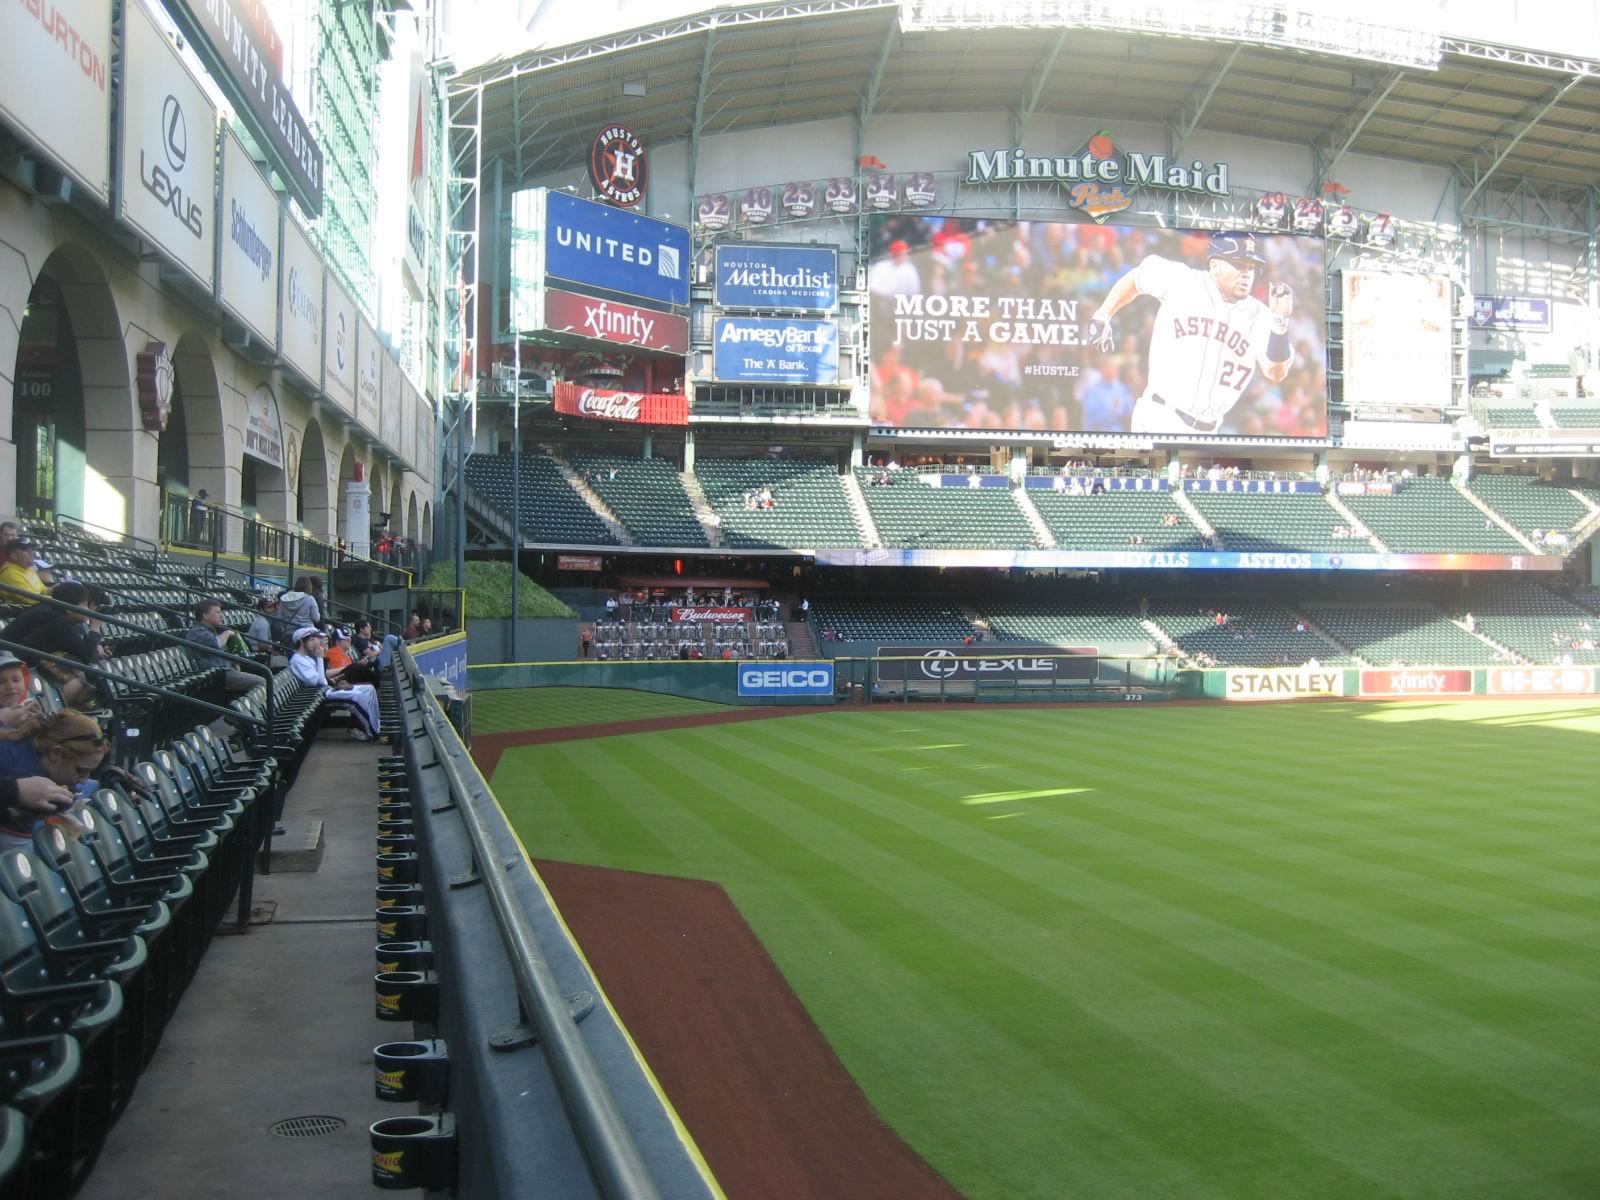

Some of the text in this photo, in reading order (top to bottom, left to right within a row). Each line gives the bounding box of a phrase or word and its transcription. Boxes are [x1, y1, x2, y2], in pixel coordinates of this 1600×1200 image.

[20, 0, 105, 92] BURTON
[272, 84, 318, 189] LEADERS
[600, 128, 643, 156] HOUSTON
[613, 149, 635, 181] H
[968, 149, 1231, 196] Minute Maid
[601, 179, 640, 202] ASTROS
[784, 182, 814, 203] 25
[827, 177, 855, 198] 33
[868, 174, 897, 194] 34
[905, 172, 935, 192] 42
[140, 149, 203, 240] LEXUS
[700, 194, 729, 215] 32
[742, 188, 772, 209] 40
[1069, 182, 1132, 212] Park
[1262, 192, 1286, 210] 49
[1297, 199, 1322, 217] 24
[1341, 206, 1353, 225] 5
[1376, 213, 1392, 233] 7
[556, 225, 653, 266] UNITED
[723, 261, 768, 269] HOUSTON
[723, 266, 832, 289] Methodist
[791, 290, 831, 298] MEDICINE
[894, 294, 1079, 321] MORE THAN
[583, 302, 655, 345] xfinity
[893, 318, 1089, 346] JUST A GAME.
[1173, 316, 1250, 358] ASTROS
[743, 358, 764, 369] The
[1024, 365, 1079, 377] #HUSTLE
[1219, 360, 1252, 391] 27
[20, 382, 52, 397] 100
[1113, 552, 1189, 568] ROYALS
[1237, 553, 1312, 569] ASTROS
[677, 608, 745, 622] Budweiser
[963, 656, 1054, 672] LEXUS
[742, 670, 830, 688] GEICO
[1230, 673, 1338, 693] STANLEY
[1389, 670, 1446, 690] xfinity
